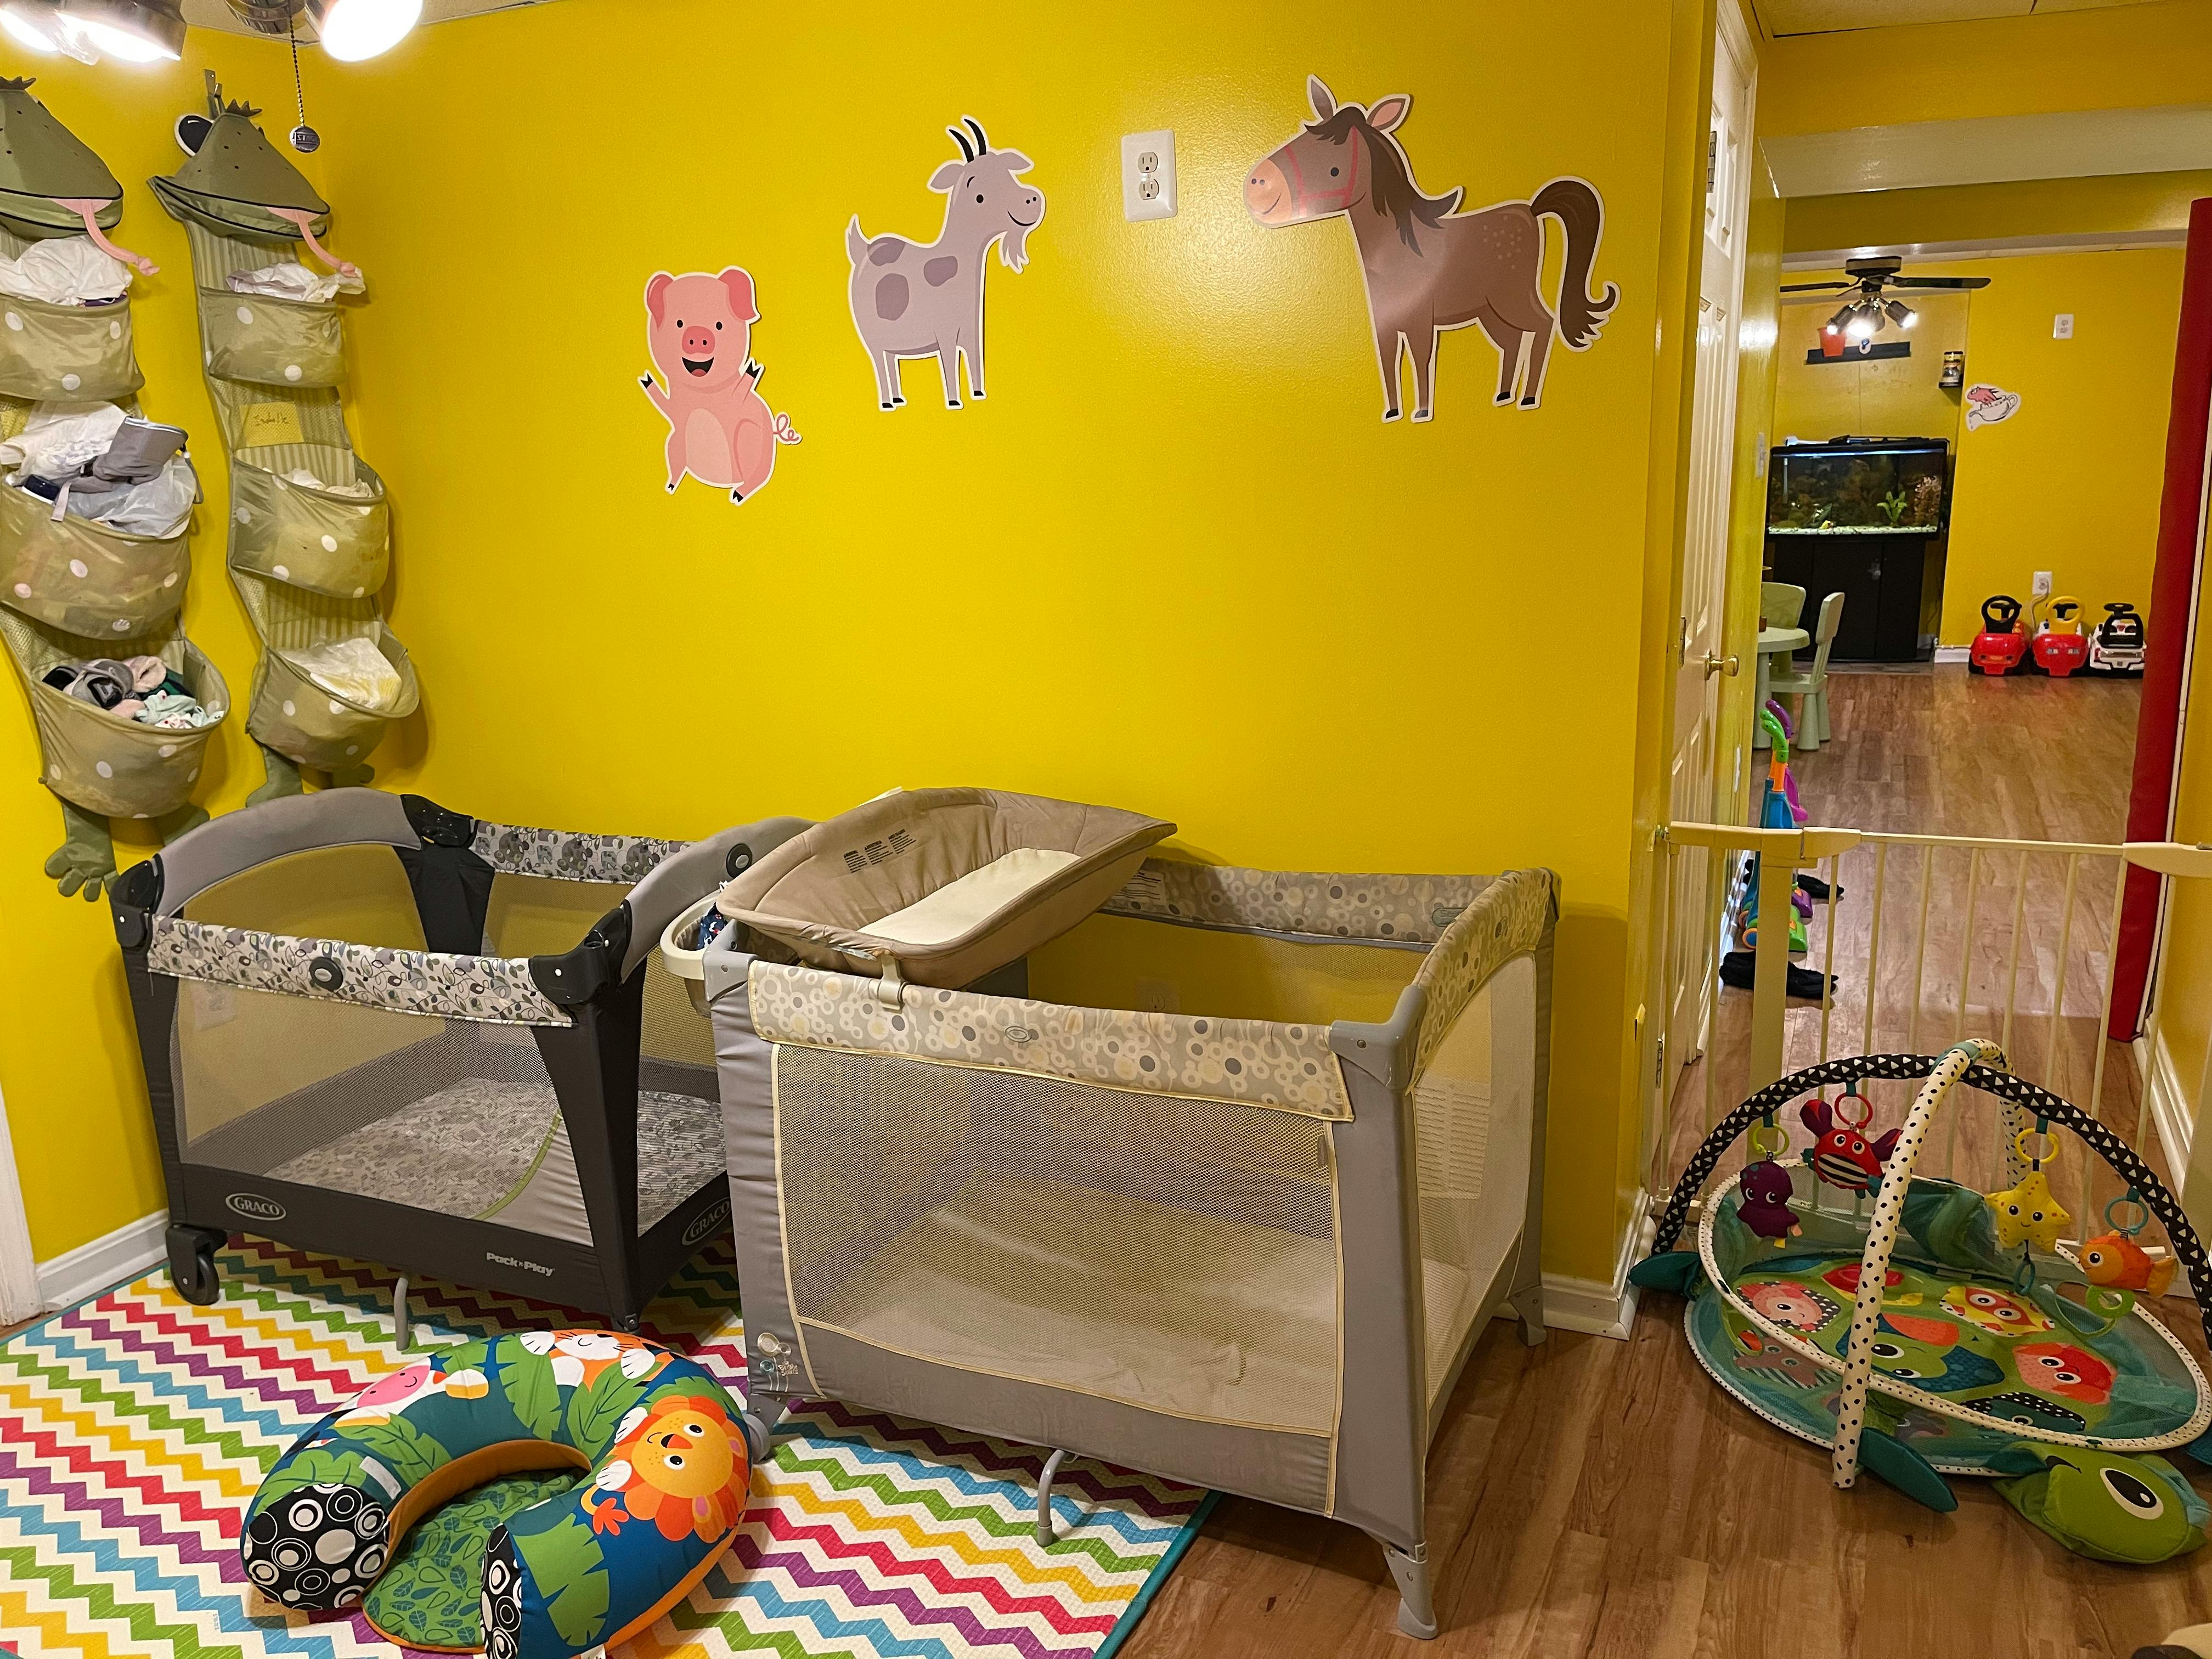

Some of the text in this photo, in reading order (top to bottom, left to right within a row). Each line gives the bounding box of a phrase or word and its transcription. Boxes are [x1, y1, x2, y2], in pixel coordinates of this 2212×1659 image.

[234, 1197, 280, 1215] GRACO
[690, 1201, 730, 1238] GRACO
[486, 1252, 518, 1267] Pack
[524, 1261, 553, 1276] Play
